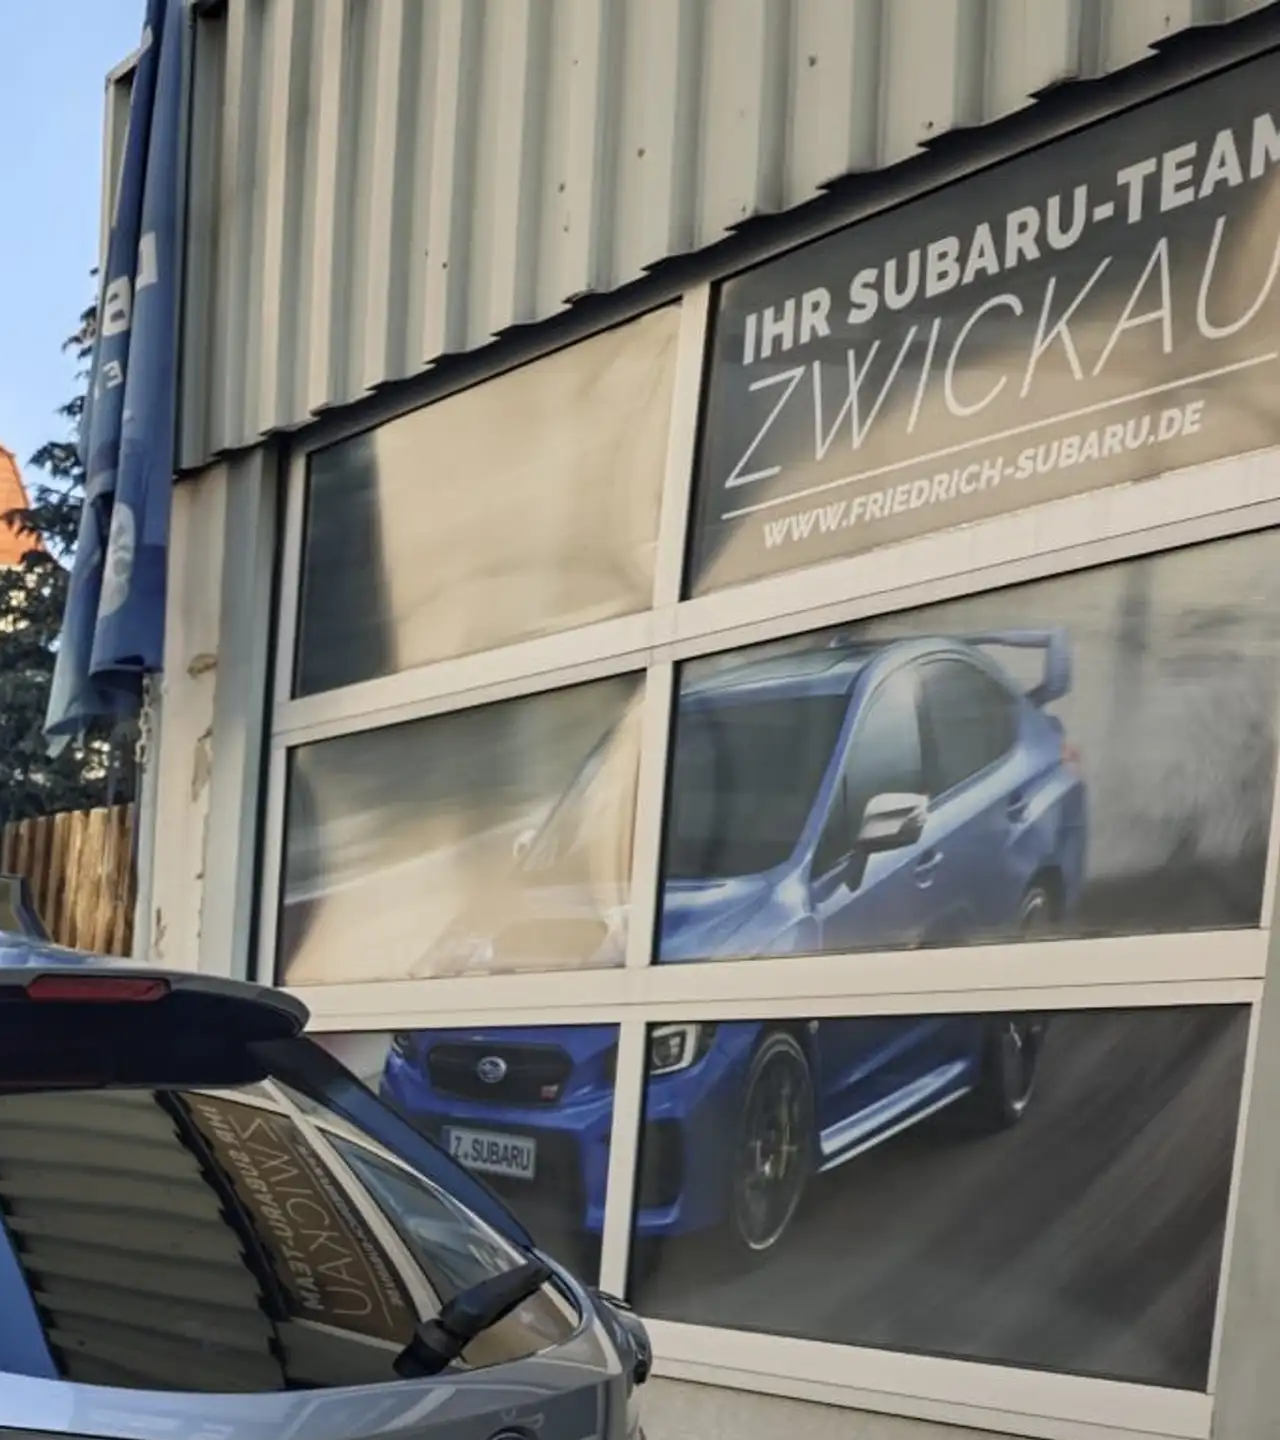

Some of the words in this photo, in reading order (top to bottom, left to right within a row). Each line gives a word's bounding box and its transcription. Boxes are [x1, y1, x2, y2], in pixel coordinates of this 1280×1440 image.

[724, 215, 1280, 489] ZWICKAU
[743, 287, 831, 366] IHR
[762, 401, 1205, 549] WWW.FRIEDRICH-SUBARU.DE
